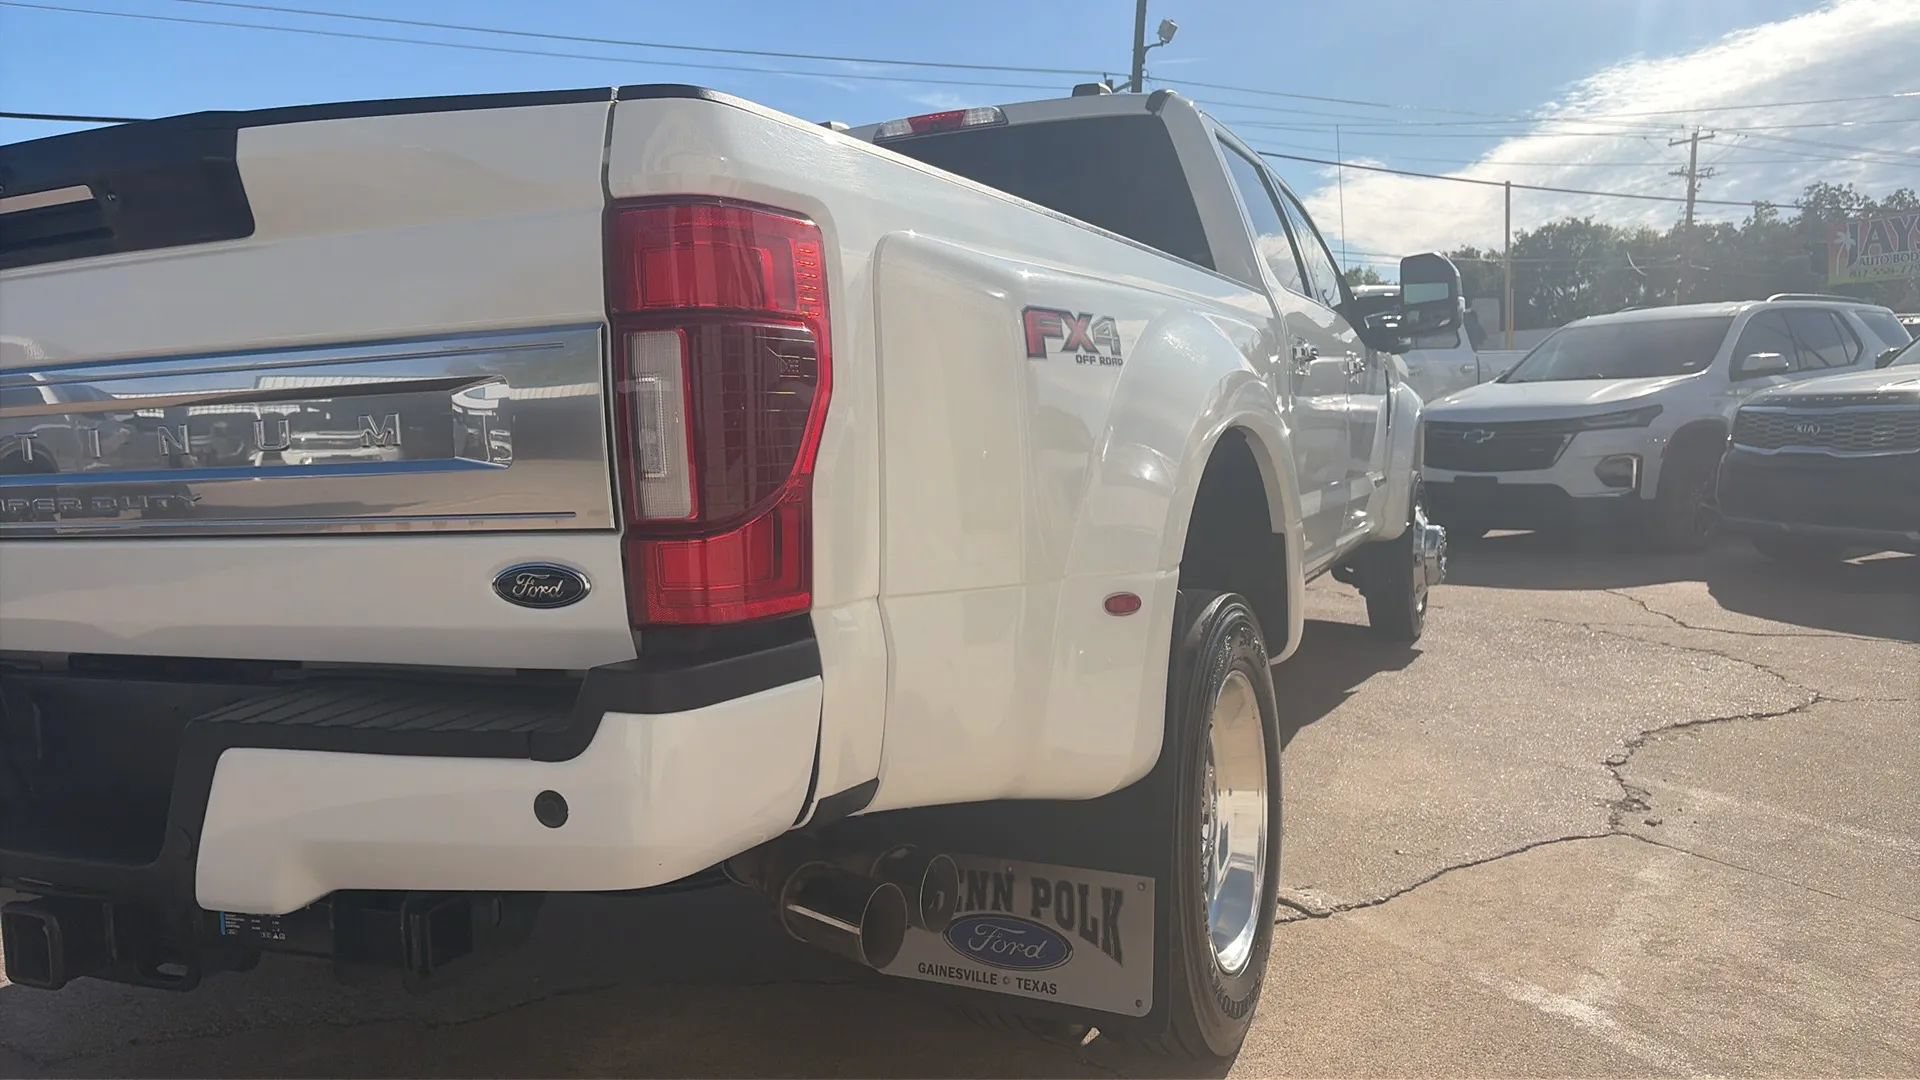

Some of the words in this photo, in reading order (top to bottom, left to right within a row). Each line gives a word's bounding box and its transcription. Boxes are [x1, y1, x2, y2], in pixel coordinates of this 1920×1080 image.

[1847, 213, 1920, 268] JAY
[1858, 254, 1889, 267] AUTO
[1892, 251, 1920, 264] BOD
[1021, 304, 1122, 359] FX4
[1075, 354, 1097, 365] OFF
[1099, 355, 1124, 367] ROAD
[1795, 422, 1817, 434] KIA
[91, 493, 201, 514] DUTY
[511, 572, 564, 598] Ford
[1029, 876, 1125, 967] POLK
[967, 923, 1048, 960] Ford
[917, 962, 998, 986] GAINESVILLE
[1016, 976, 1058, 995] TEXAS
